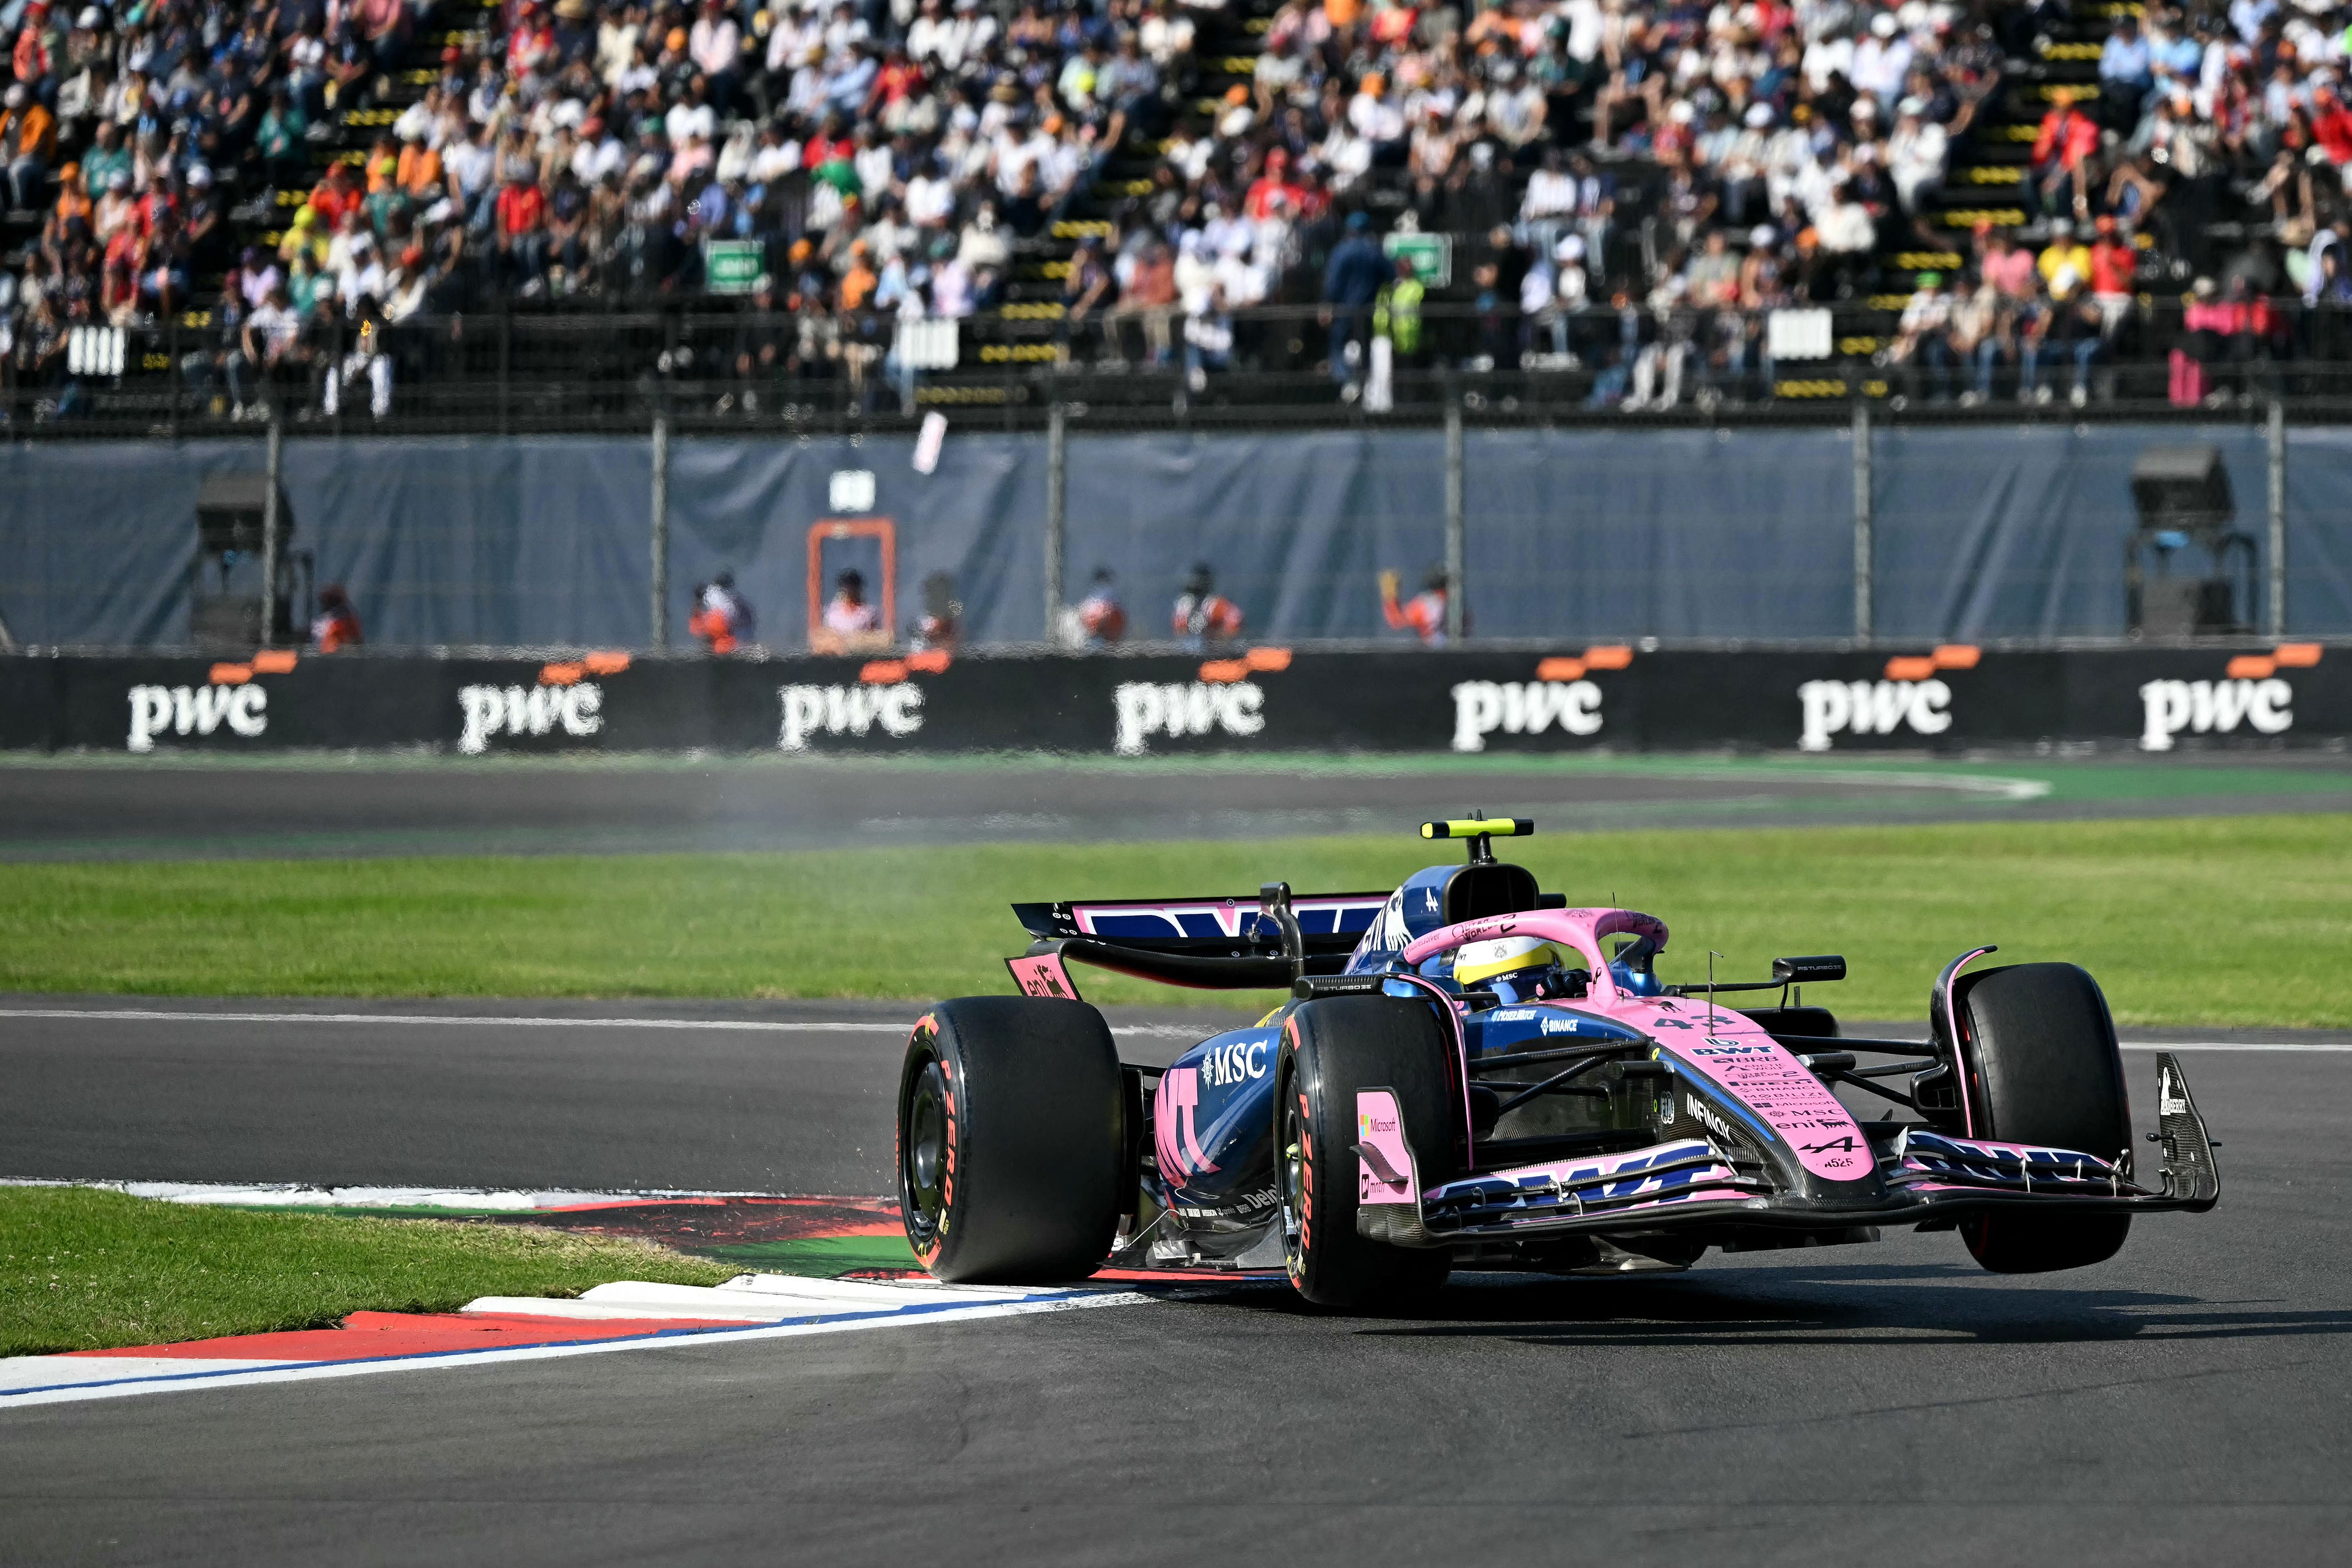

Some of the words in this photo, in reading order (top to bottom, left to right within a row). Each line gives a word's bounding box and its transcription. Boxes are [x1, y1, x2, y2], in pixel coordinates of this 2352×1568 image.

[127, 683, 267, 752] pwc
[457, 681, 604, 755] pwc
[778, 682, 925, 753] pwc
[1113, 680, 1266, 756] pwc
[1453, 681, 1603, 752] pwc
[1801, 680, 1951, 752] pwc
[2142, 679, 2293, 751] pwc
[1501, 972, 1518, 981] MSC
[1549, 1019, 1578, 1032] BINANCE
[1653, 1015, 1737, 1029] 43
[1689, 1045, 1775, 1056] BWT
[1215, 1039, 1268, 1086] MSC
[1370, 1118, 1396, 1132] Microsoft
[1686, 1092, 1735, 1145] INFINOX
[1775, 1119, 1816, 1129] eni
[2160, 1099, 2187, 1114] OAKBERRY
[944, 1090, 956, 1206] ZERO
[1302, 1129, 1313, 1250] ZERO
